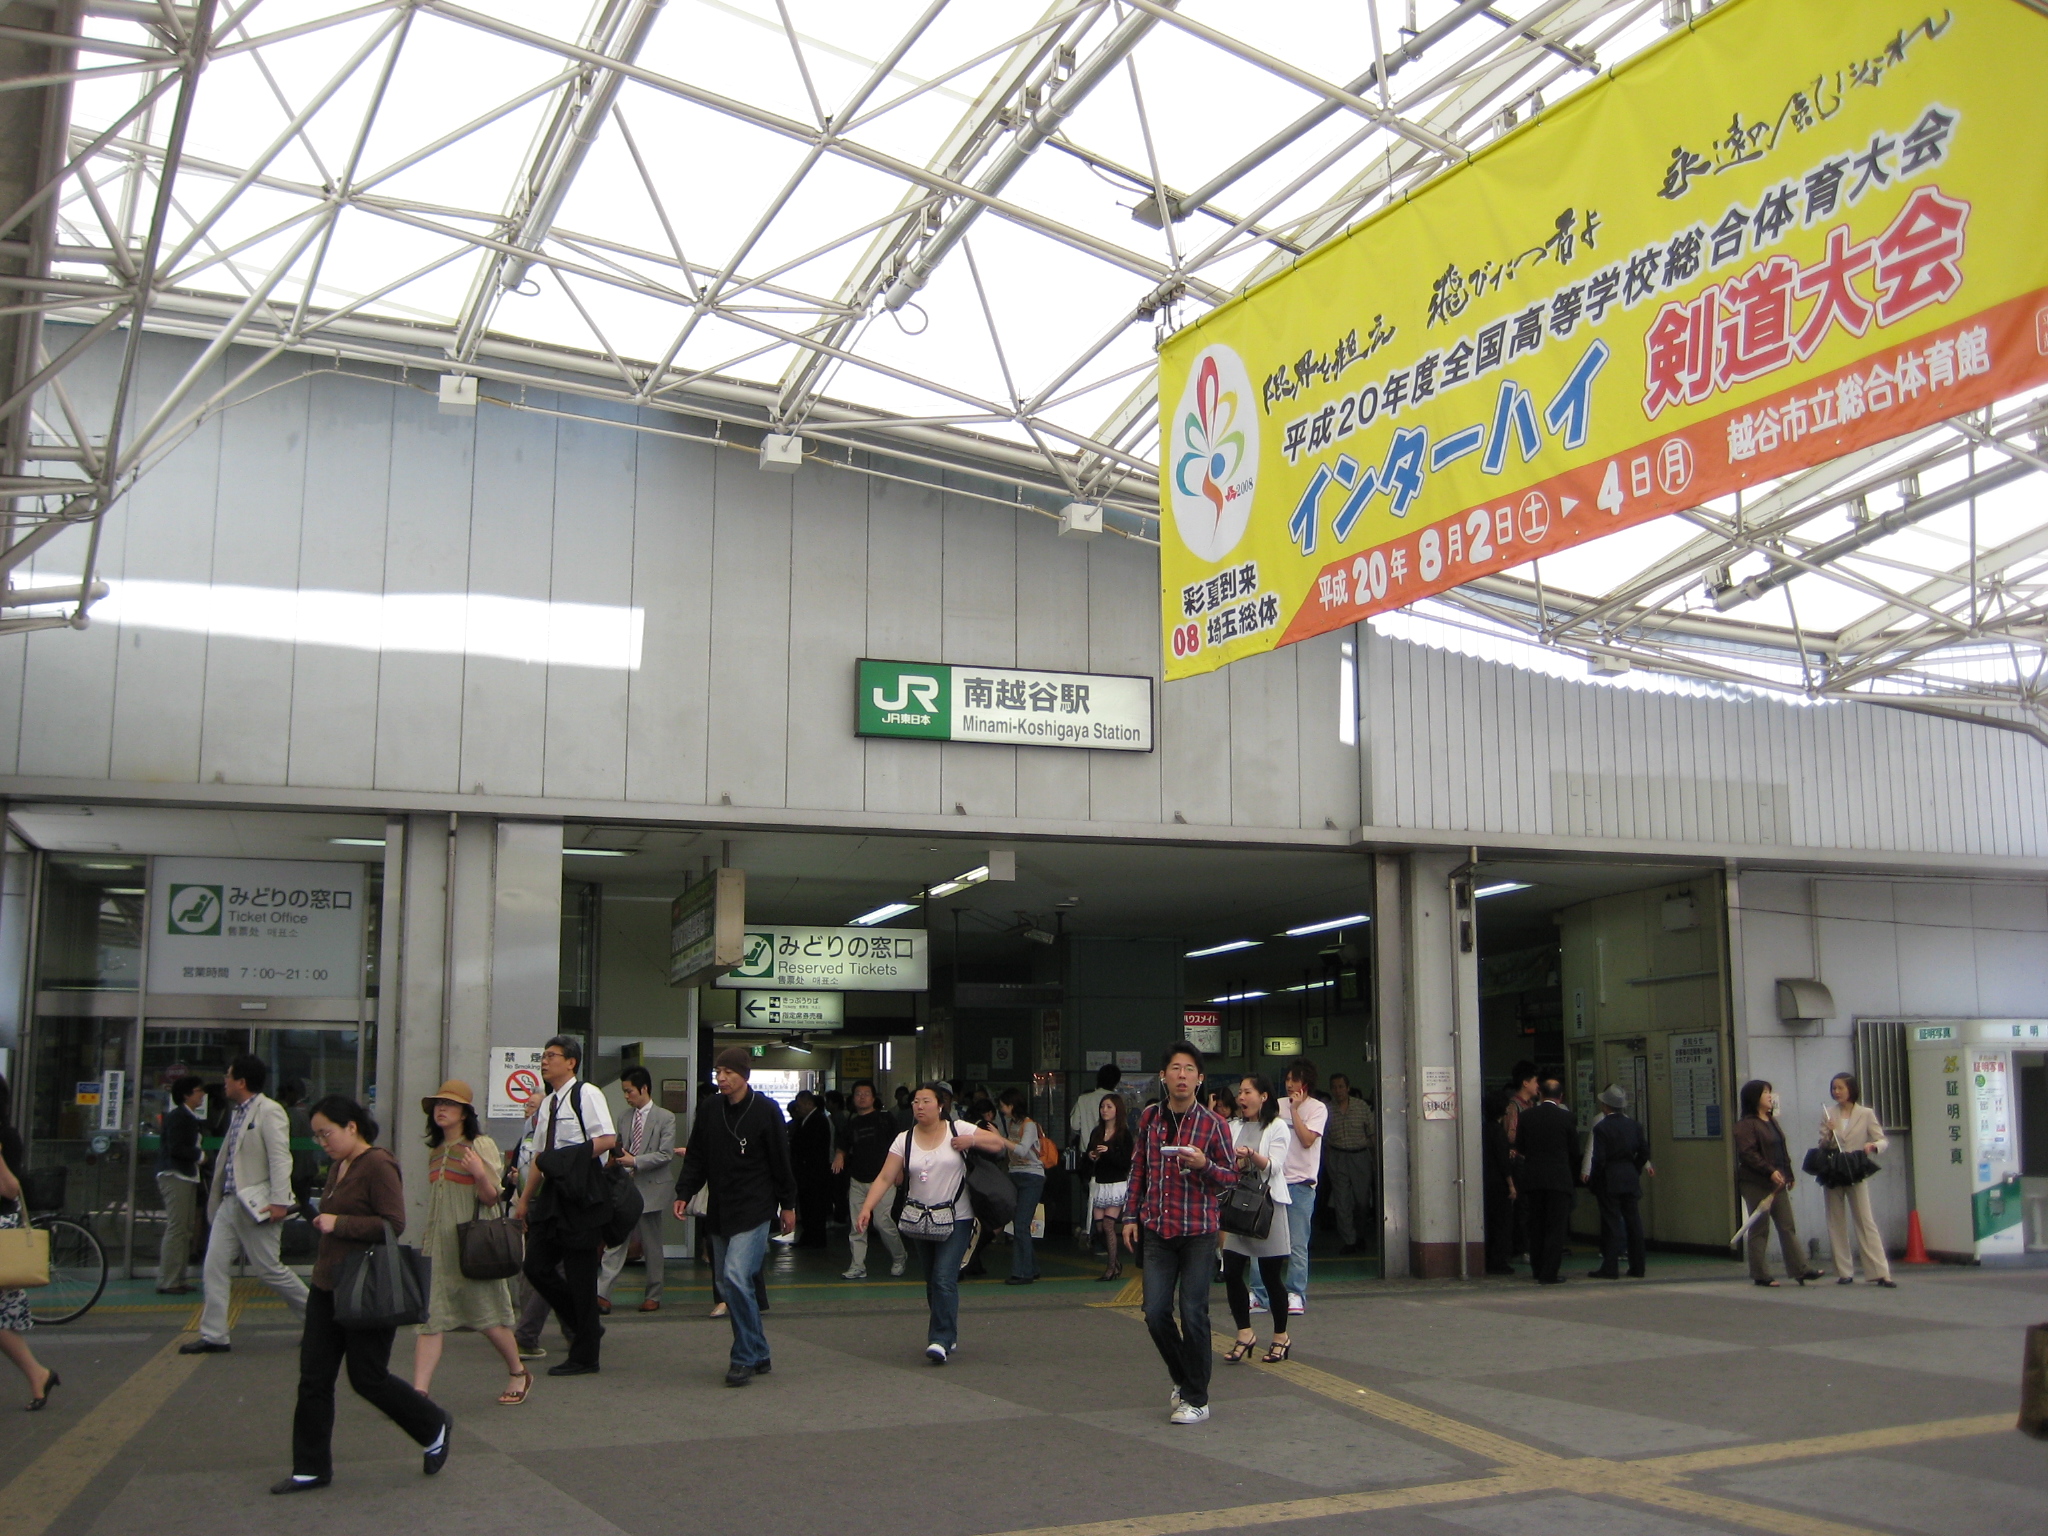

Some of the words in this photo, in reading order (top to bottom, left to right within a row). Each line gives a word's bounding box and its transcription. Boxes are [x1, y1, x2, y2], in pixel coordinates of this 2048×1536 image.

[1283, 109, 1955, 461] 平成20年度全国高等学校総合体育大会
[1289, 338, 1609, 556] インターハイ
[1643, 184, 1971, 420] 剣道大会
[1727, 325, 1990, 464] 越谷市立総合体育館
[1236, 480, 1254, 497] 2008
[1183, 564, 1256, 616] 彩夏到来
[1174, 625, 1199, 657] 08
[1207, 597, 1278, 645] 埼玉総体
[873, 674, 940, 713] JR
[963, 677, 1090, 715] 南越谷駅
[882, 712, 931, 725] JR東日本
[963, 715, 1089, 742] Minami-Koshigaya
[1093, 722, 1141, 742] Station
[229, 887, 352, 910] みどりの窓口
[229, 910, 266, 924] Ticket
[270, 911, 308, 924] Office
[779, 935, 913, 959] みどりの窓口
[182, 966, 229, 979] 営業時間
[778, 960, 844, 975] Reserved
[849, 962, 898, 976] Tickets
[782, 997, 819, 1005] きっぷうりば
[1184, 1014, 1218, 1024] ハウスメイト
[1919, 1027, 1951, 1040] 証明写真
[1946, 1080, 1963, 1165] 証明写真
